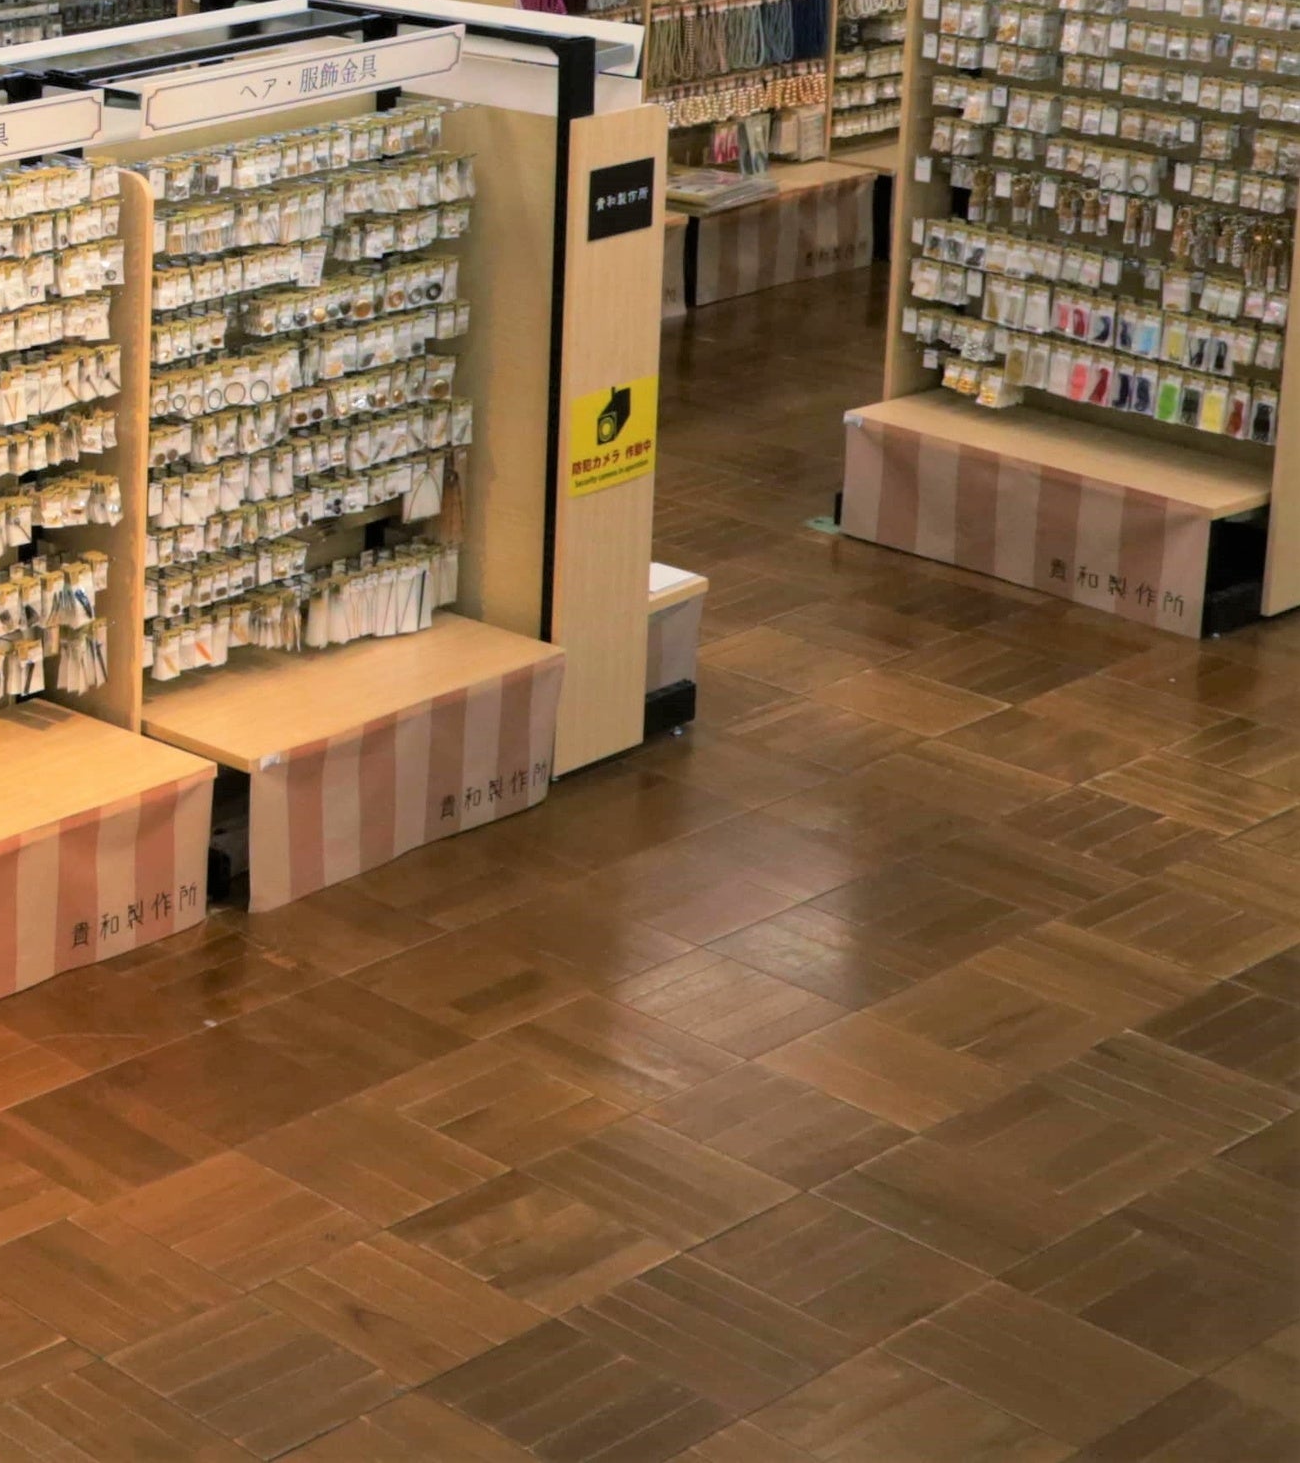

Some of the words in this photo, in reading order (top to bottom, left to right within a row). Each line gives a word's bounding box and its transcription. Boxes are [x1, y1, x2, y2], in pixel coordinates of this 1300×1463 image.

[239, 55, 378, 101] ヘア・服飾金具
[595, 185, 650, 214] 貴和製作所
[1049, 557, 1185, 619] 貴和製作所
[438, 759, 549, 821] 貴和製作所
[70, 881, 198, 949] 貴和製作所
